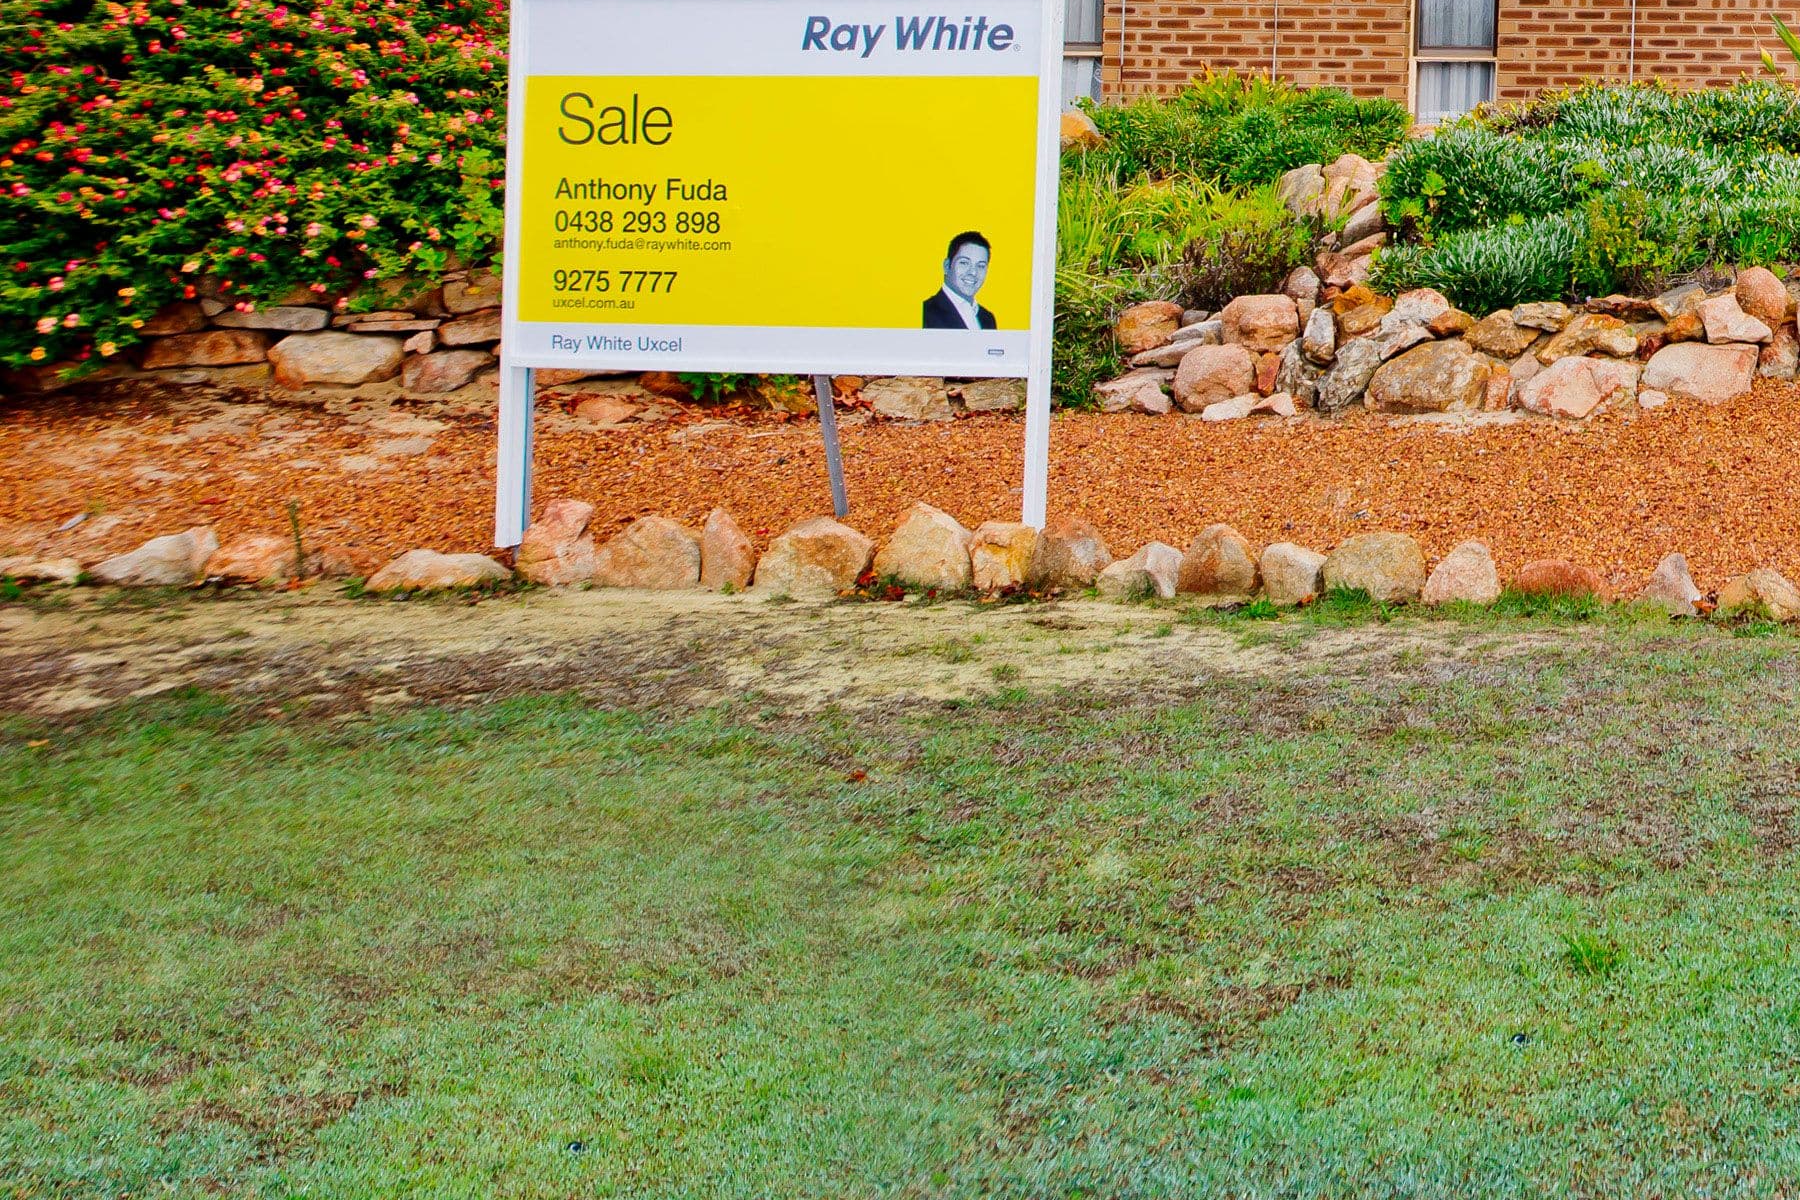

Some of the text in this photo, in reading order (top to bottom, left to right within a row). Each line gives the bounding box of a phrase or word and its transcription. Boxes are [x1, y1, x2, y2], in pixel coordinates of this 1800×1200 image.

[802, 16, 1014, 58] Ray White
[558, 91, 673, 146] Sale
[555, 177, 728, 206] Anthony Fuda
[555, 210, 721, 234] 0438 293 898
[554, 237, 732, 253] anthony.fuda@raywhite.com
[553, 269, 678, 293] 9275 7777
[553, 297, 636, 310] uxcel.com.au
[552, 334, 683, 354] Ray White Uxcel
